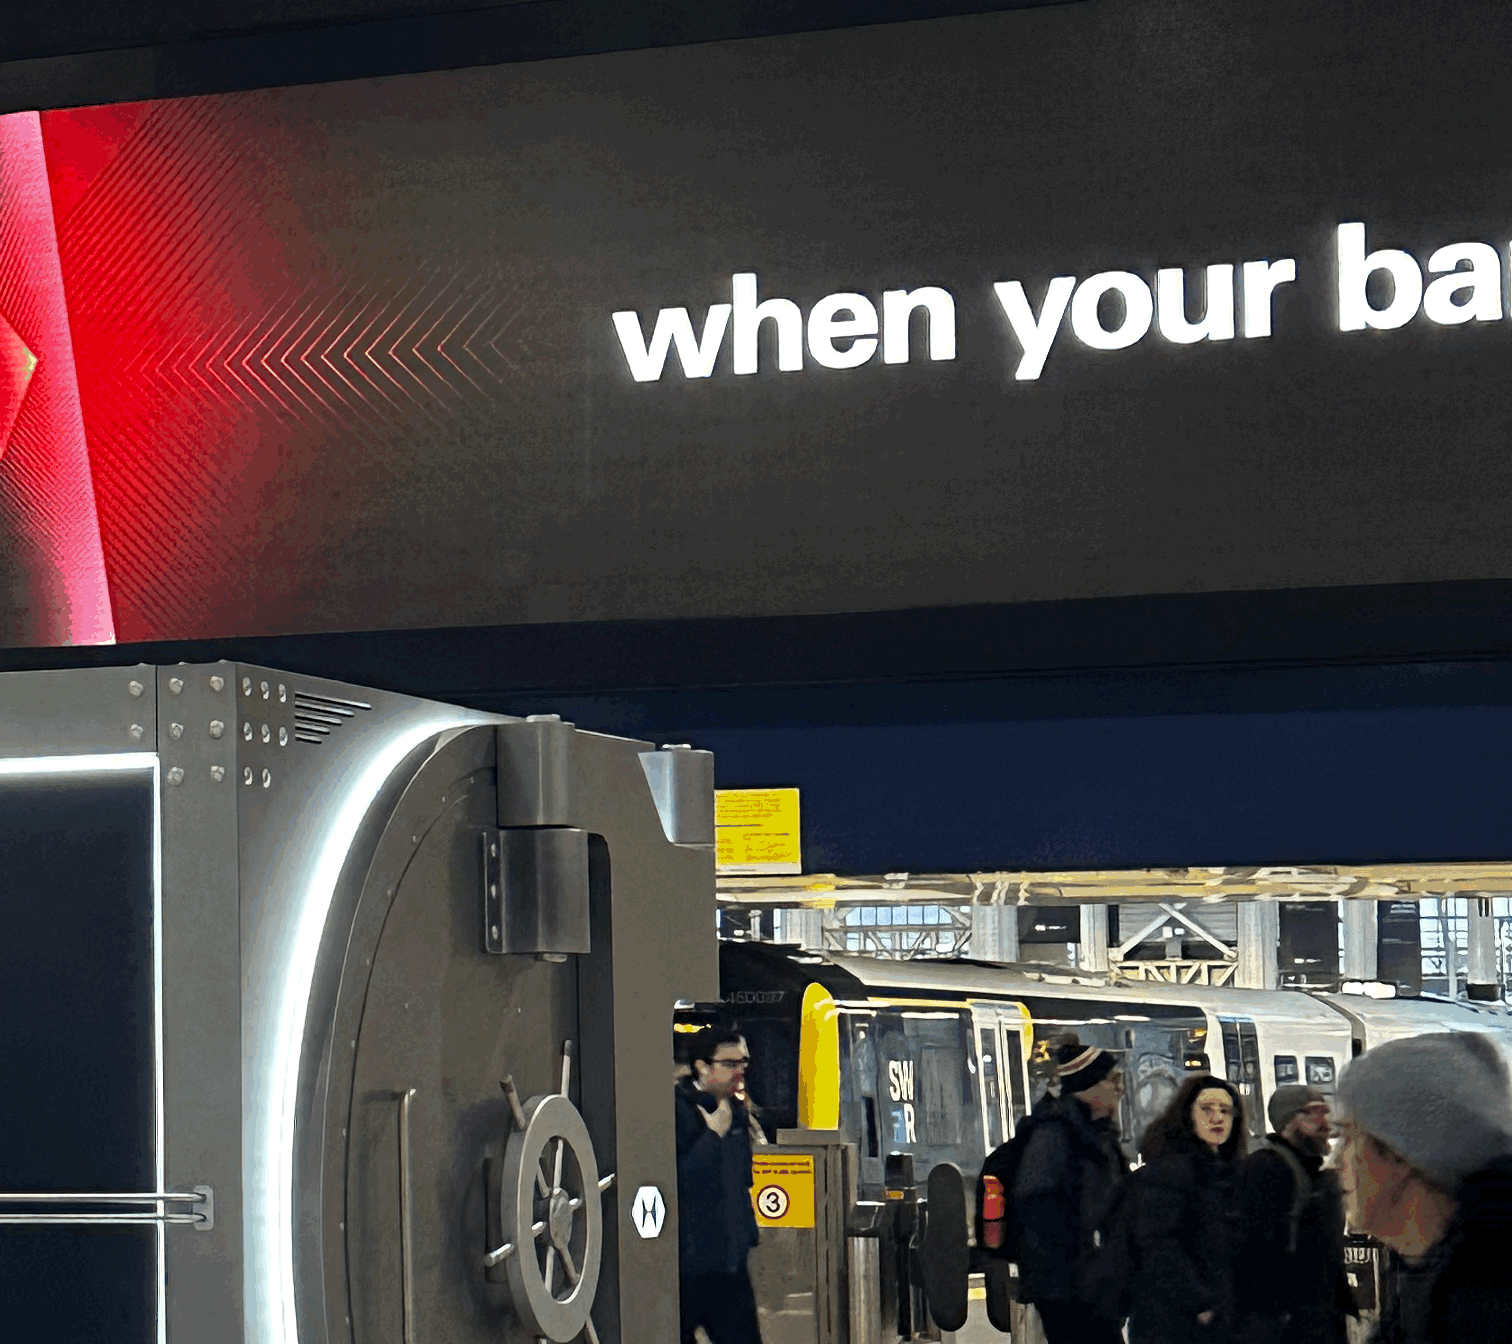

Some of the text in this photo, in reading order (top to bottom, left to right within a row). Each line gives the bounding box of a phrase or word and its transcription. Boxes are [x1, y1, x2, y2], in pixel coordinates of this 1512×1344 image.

[612, 223, 1512, 382] when your ba
[888, 1060, 914, 1102] SW
[903, 1103, 917, 1143] R
[766, 1191, 781, 1213] 3
